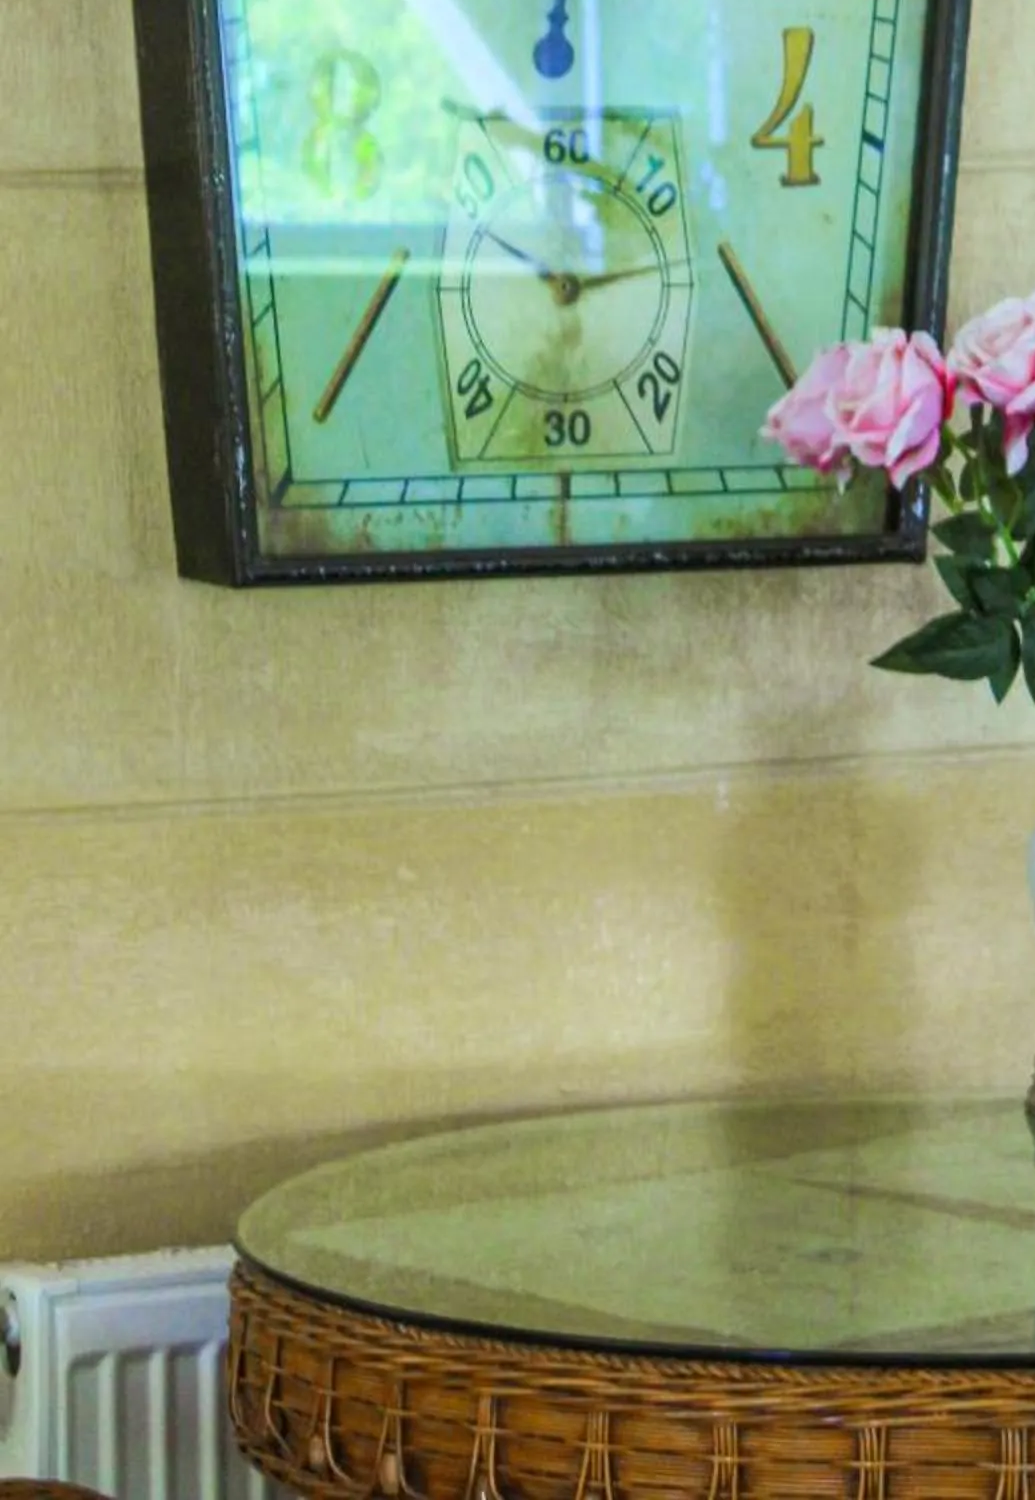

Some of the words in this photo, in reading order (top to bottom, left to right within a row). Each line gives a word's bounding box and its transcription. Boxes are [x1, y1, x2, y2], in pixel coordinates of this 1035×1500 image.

[751, 27, 824, 187] 4
[543, 128, 590, 164] 60
[455, 153, 494, 219] 50
[635, 153, 677, 217] 10
[456, 358, 494, 419] 40
[637, 351, 681, 422] 20
[544, 410, 591, 446] 30
